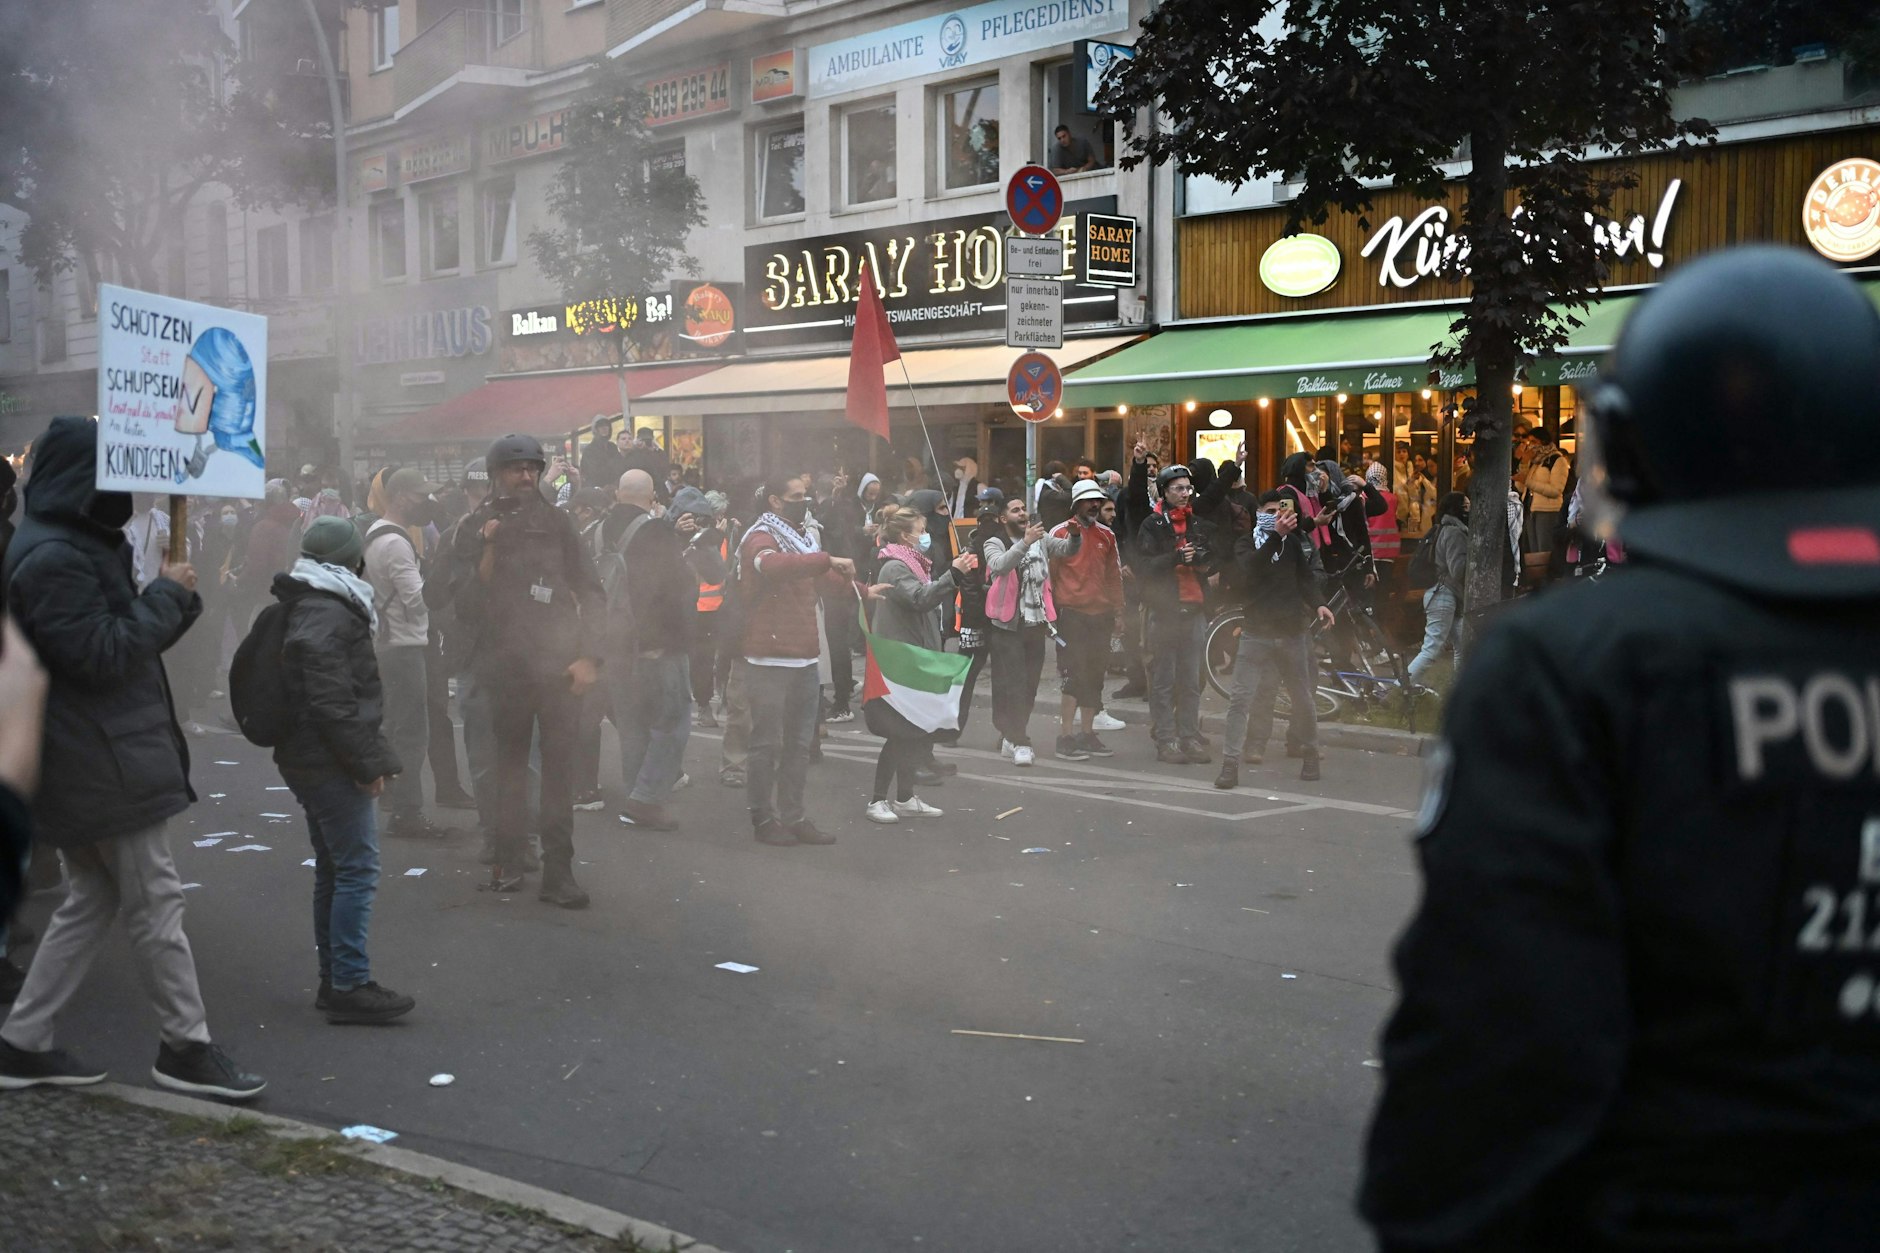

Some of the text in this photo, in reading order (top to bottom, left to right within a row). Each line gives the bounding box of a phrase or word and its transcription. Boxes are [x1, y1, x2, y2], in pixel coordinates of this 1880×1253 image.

[827, 0, 1116, 77] AMBULANTE PFLEGEDIENST
[681, 76, 706, 114] 295
[710, 69, 727, 102] 44
[1089, 224, 1133, 243] SARAY
[928, 222, 1077, 296] HOE
[1010, 245, 1059, 256] Be- und Entladen
[1091, 245, 1130, 264] HOME
[1028, 258, 1042, 268] frei
[1011, 283, 1059, 296] nur innerhalb
[844, 301, 983, 328] HATSWARENGESCHÄFT
[1020, 302, 1050, 312] gekenn-
[111, 301, 193, 345] SCHÜTZEN
[512, 311, 557, 336] Balkan
[1017, 317, 1053, 327] zeichneter
[1014, 331, 1056, 343] Parkflächen
[1297, 376, 1338, 393] Baklava
[1364, 372, 1402, 390] Katmer
[1428, 369, 1463, 388] izza
[105, 443, 181, 480] KÜNDIGEN
[467, 471, 489, 480] PRESS
